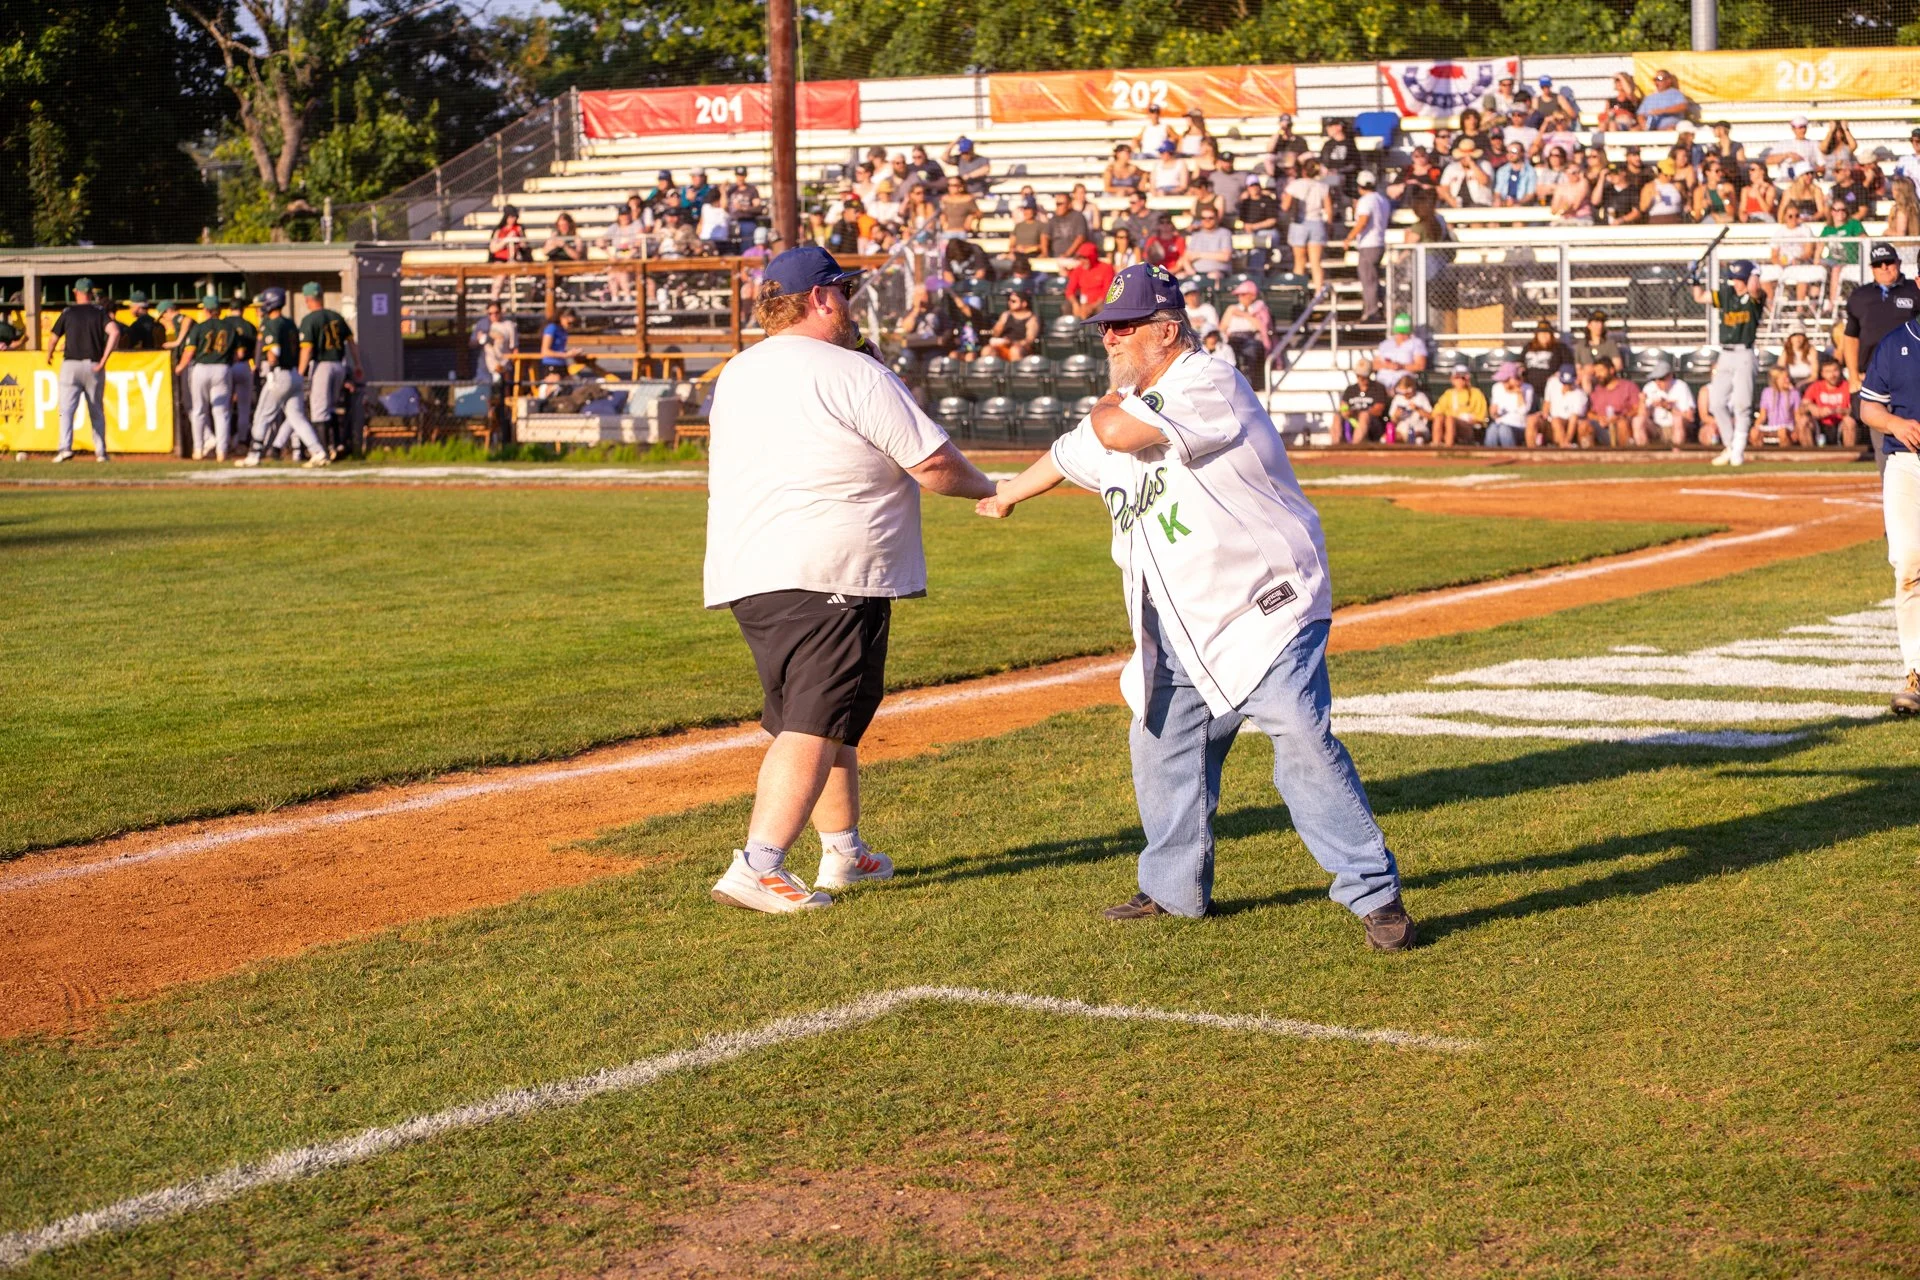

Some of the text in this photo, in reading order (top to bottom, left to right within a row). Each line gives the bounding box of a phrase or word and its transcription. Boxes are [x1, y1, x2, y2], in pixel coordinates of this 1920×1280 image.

[1776, 60, 1837, 91] 203
[695, 96, 743, 124] 201
[1112, 80, 1168, 109] 202
[33, 369, 164, 431] PTY
[1157, 501, 1192, 544] K
